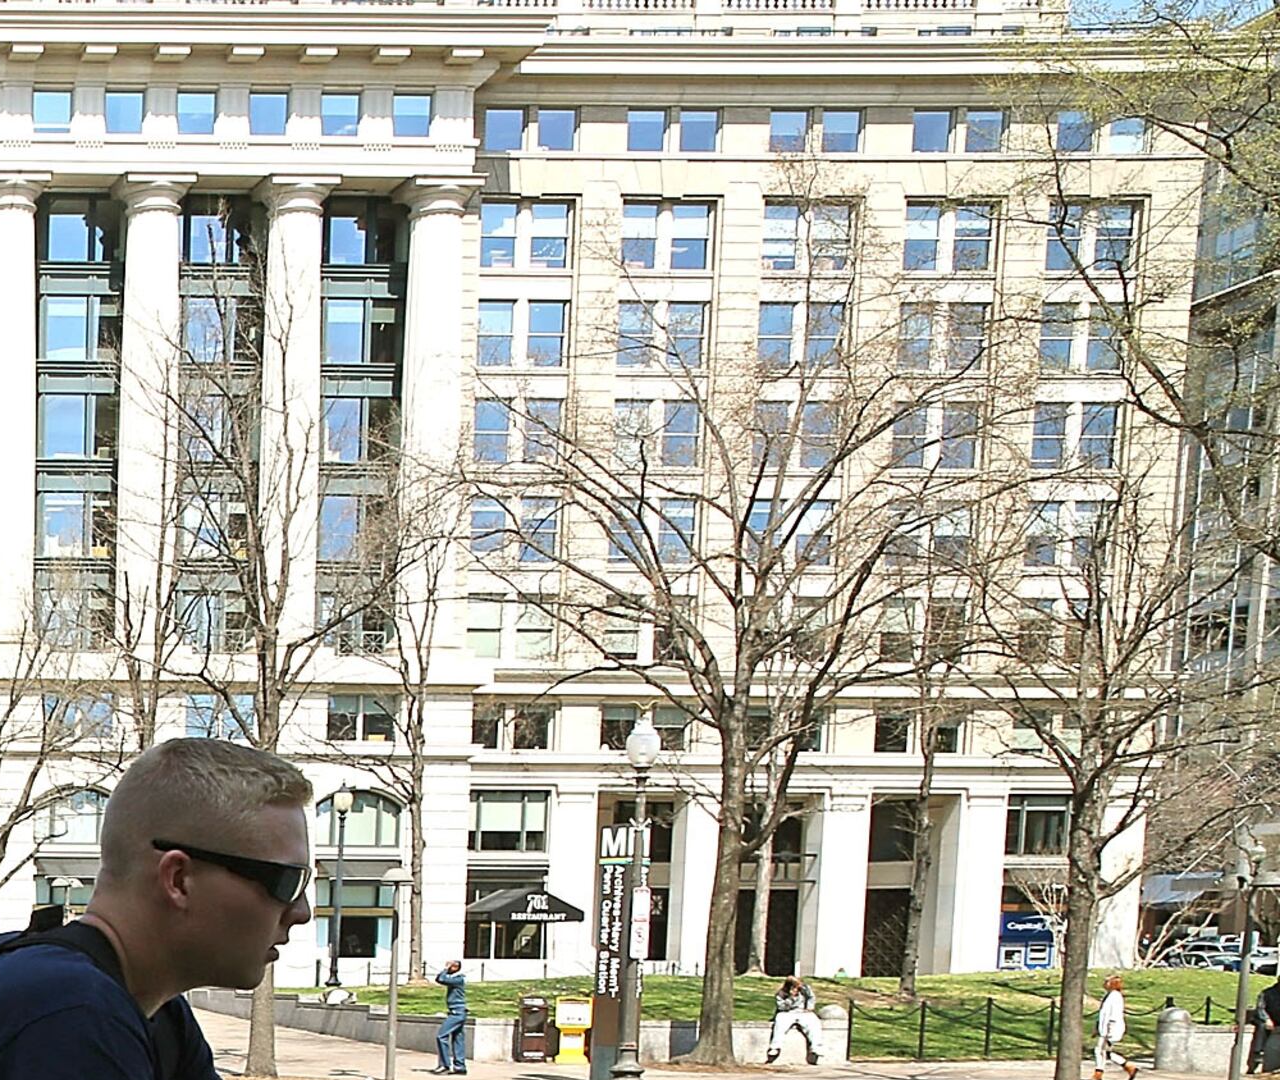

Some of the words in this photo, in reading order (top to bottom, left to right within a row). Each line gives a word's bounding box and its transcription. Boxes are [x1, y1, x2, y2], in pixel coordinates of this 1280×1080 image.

[603, 865, 614, 895] Penn
[511, 912, 566, 921] RESTAURANT
[600, 900, 612, 945] Quarter
[597, 950, 610, 994] Station
